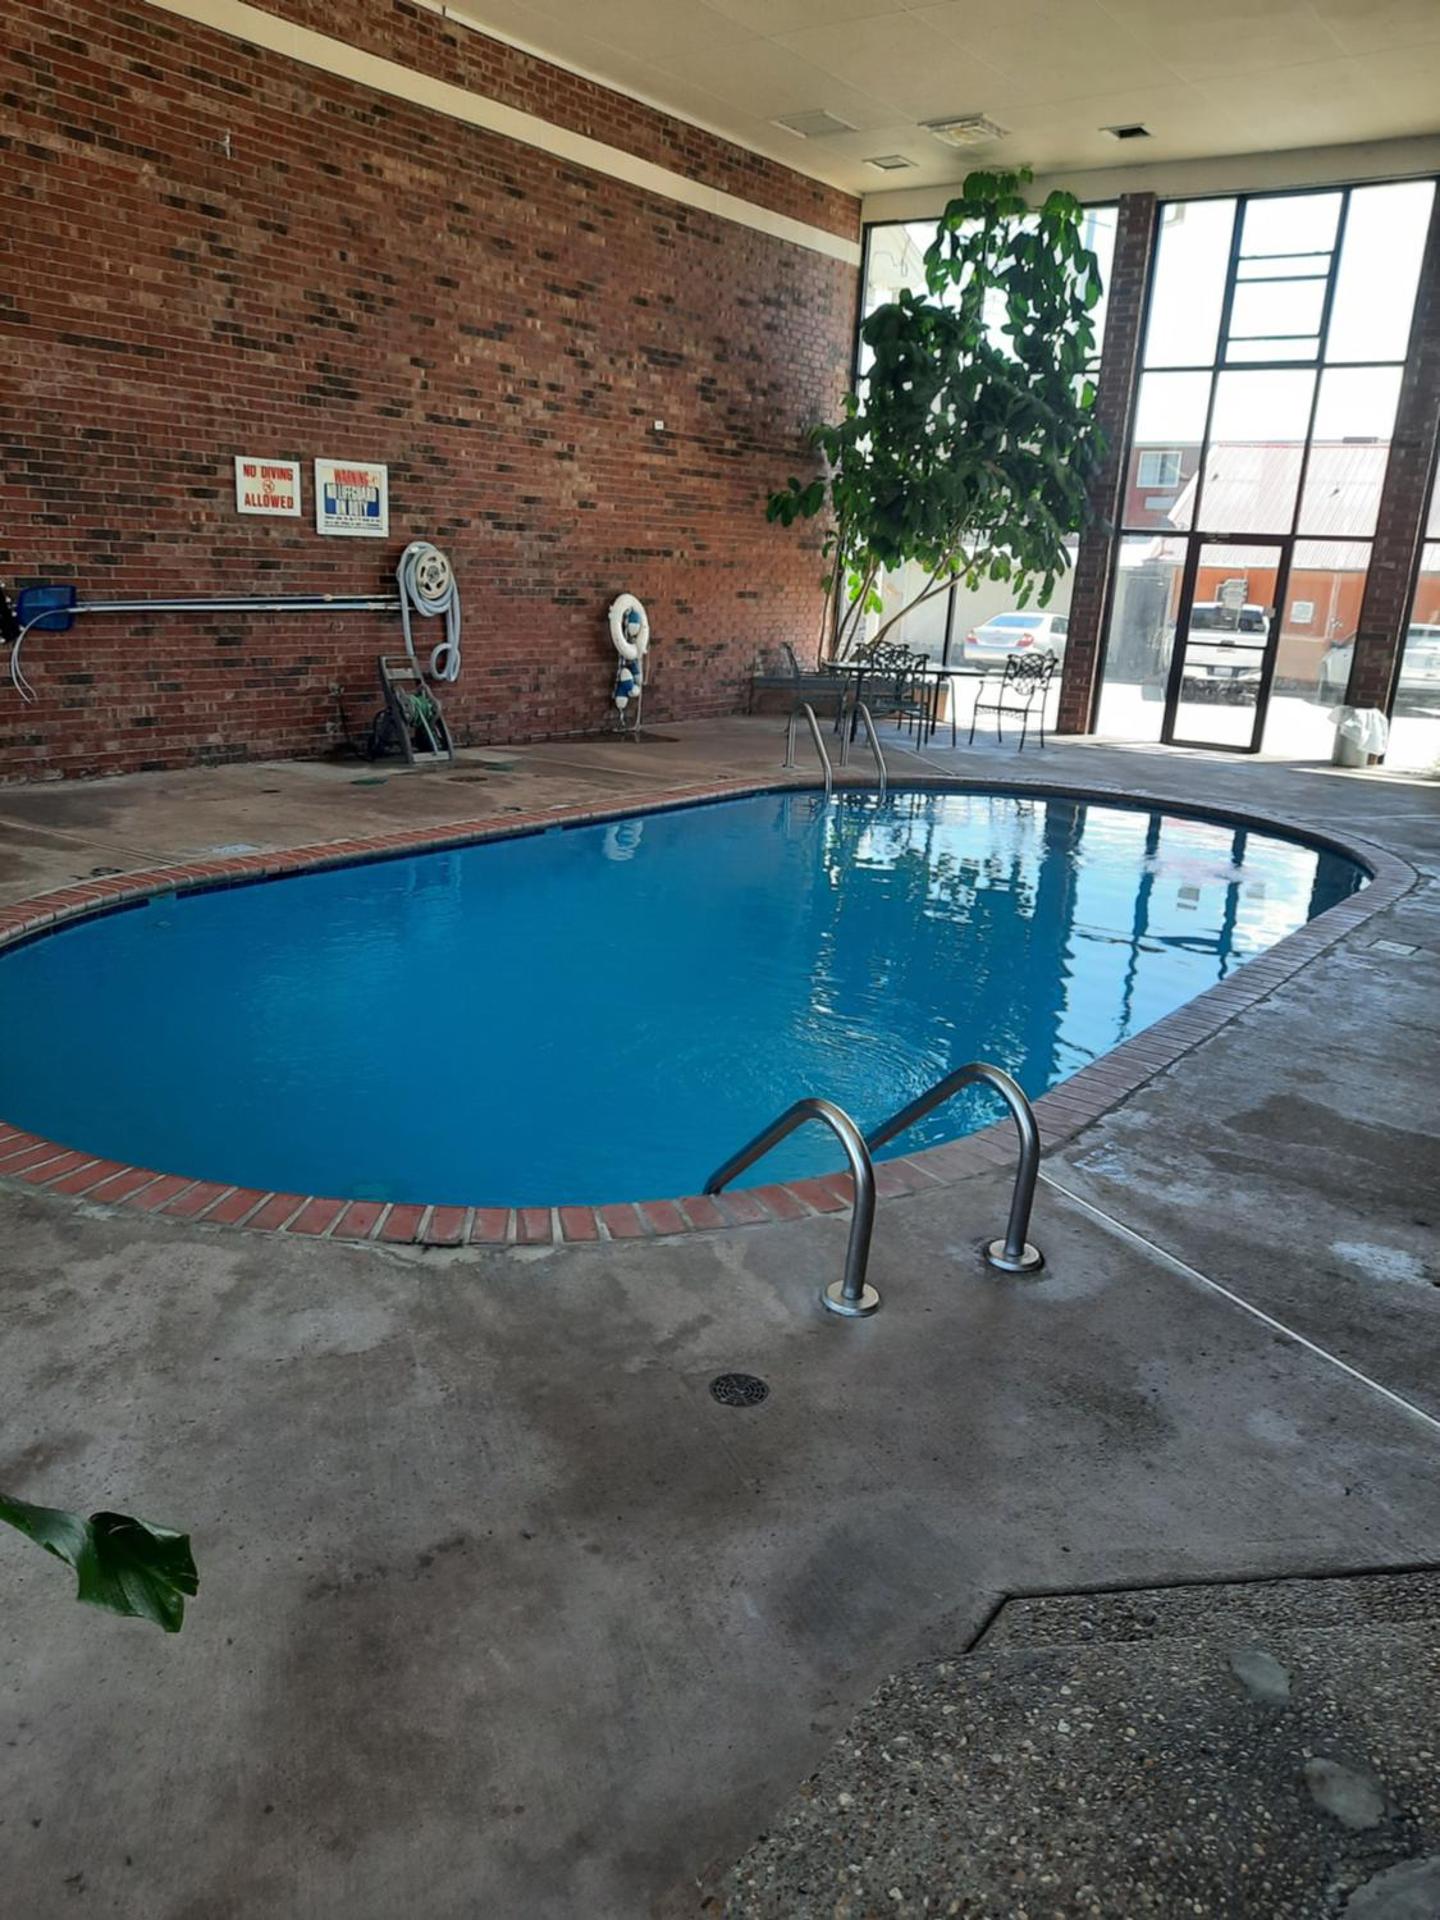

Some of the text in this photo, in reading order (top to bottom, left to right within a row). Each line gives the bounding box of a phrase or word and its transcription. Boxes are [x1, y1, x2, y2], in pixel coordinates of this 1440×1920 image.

[243, 464, 293, 481] NO DIVING
[334, 469, 369, 487] WARNING
[244, 493, 294, 509] ALLOWED
[327, 483, 377, 502] NO LIFEGUARD
[335, 499, 369, 516] ON DUTY
